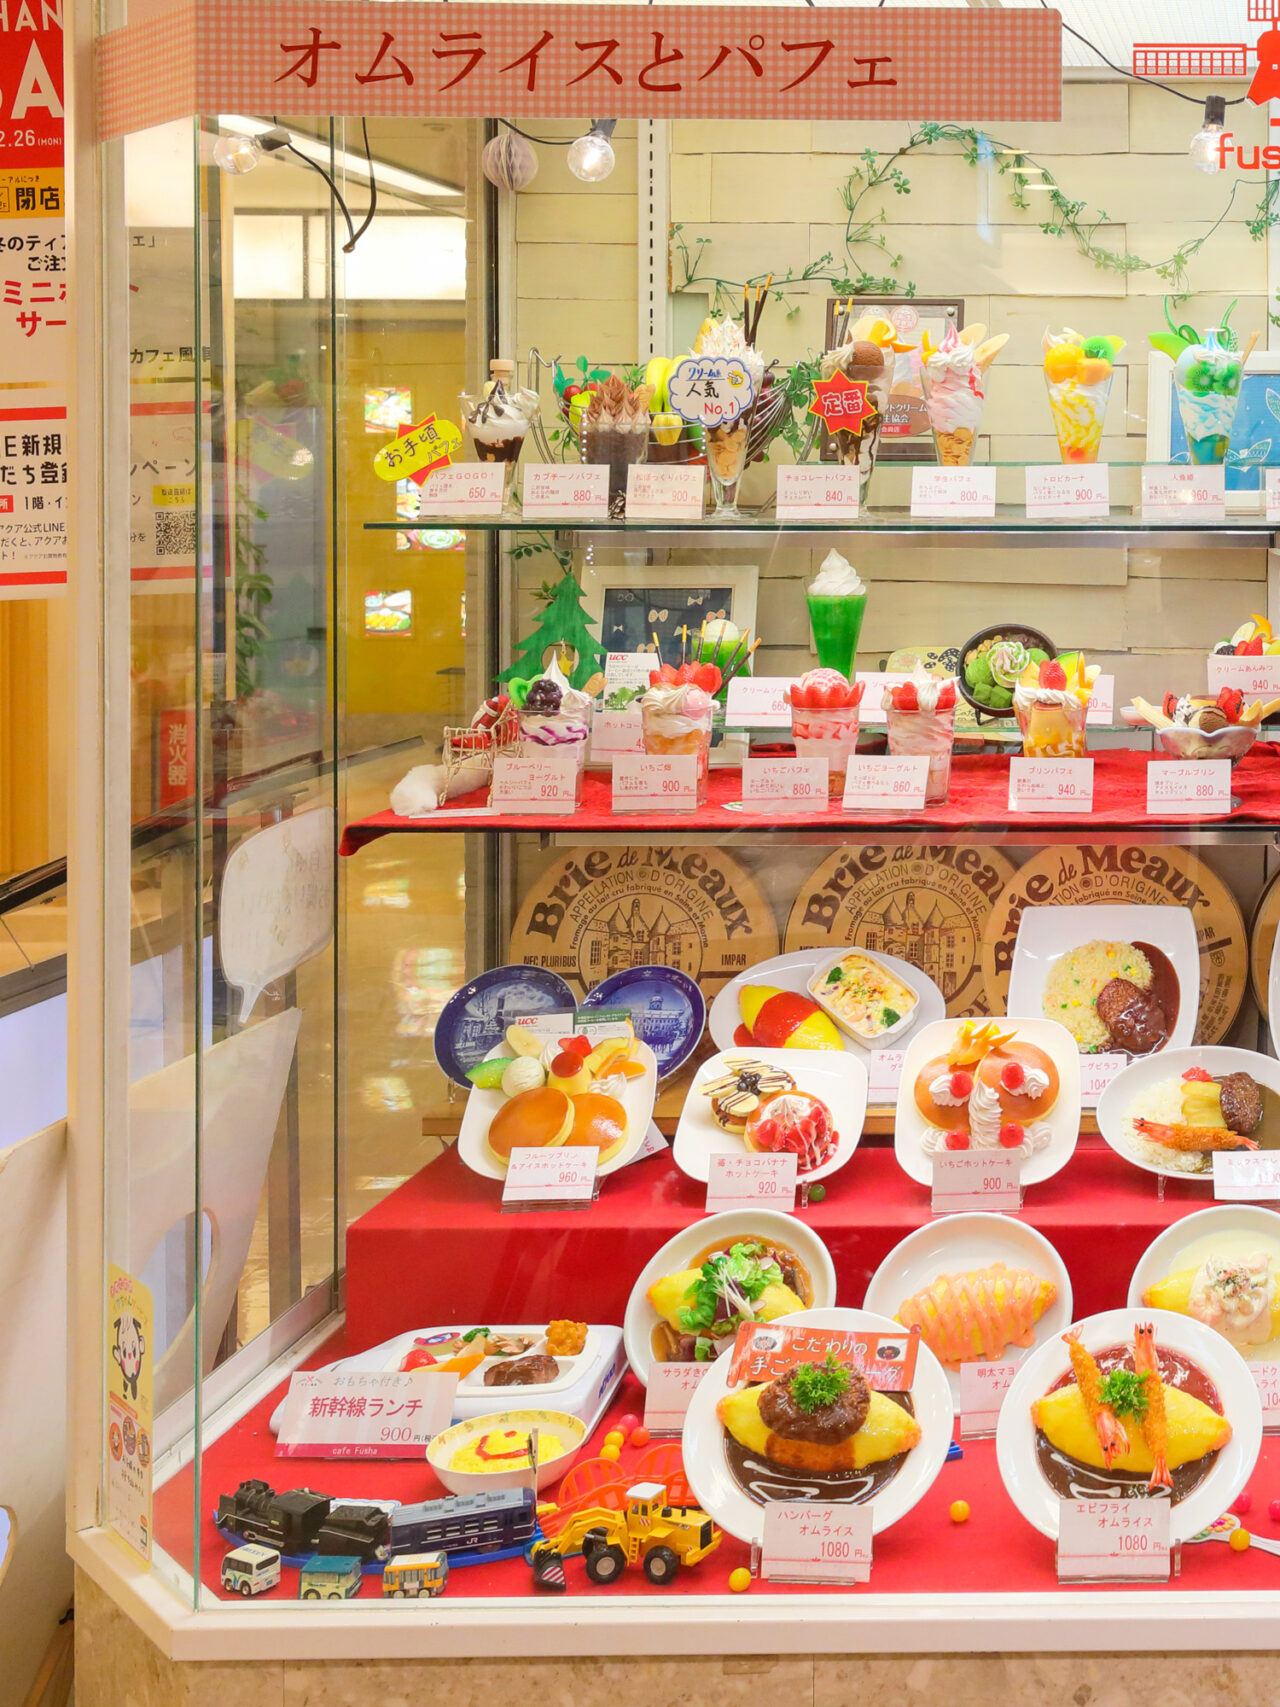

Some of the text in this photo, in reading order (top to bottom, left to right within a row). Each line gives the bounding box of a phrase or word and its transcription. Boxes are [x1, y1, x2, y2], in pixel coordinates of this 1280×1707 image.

[273, 26, 898, 93] オムライスとパフェ
[37, 138, 62, 146] (MON)
[15, 186, 60, 211] 閉店
[27, 254, 65, 272] ご注
[686, 380, 720, 399] 人気
[703, 401, 735, 416] No.1
[821, 388, 863, 417] 定番
[384, 423, 442, 469] お手頃
[426, 437, 463, 462] パフェ
[785, 473, 854, 482] チョコレートパフェ
[468, 487, 487, 499] 650
[573, 490, 591, 502] 880
[671, 490, 688, 502] 900
[825, 490, 843, 502] 840
[960, 490, 978, 502] 800
[1075, 489, 1093, 500] 900
[1251, 680, 1269, 691] 940
[506, 763, 552, 772] ブルーベリー
[640, 764, 672, 772] いちご畑
[762, 767, 811, 775] いちごパフェ
[858, 764, 919, 773] いちごヨーグルト
[1028, 767, 1073, 776] プリンパフェ
[529, 773, 566, 782] ヨーグルト
[541, 785, 558, 797] 920
[662, 780, 680, 792] 900
[792, 783, 811, 795] 880
[892, 781, 910, 793] 860
[1058, 783, 1076, 796] 940
[1196, 784, 1214, 796] 880
[1076, 845, 1211, 909] Meaux
[721, 953, 747, 966] IMPAR
[524, 1152, 579, 1160] フルーツプリン
[939, 1159, 1013, 1169] いちごホットケーキ
[558, 1171, 577, 1184] 960
[725, 1169, 779, 1178] ホットケーキ
[758, 1181, 776, 1194] 920
[983, 1176, 1001, 1190] 900
[791, 1334, 868, 1355] こだわりの
[977, 1367, 1015, 1378] 明太マヨ
[307, 1395, 424, 1419] 新幹線ランチ
[379, 1426, 413, 1442] 900
[331, 1446, 378, 1456] cafe Fusha
[1076, 1503, 1131, 1515] エビフライ
[777, 1510, 834, 1521] ハンバーグ
[1097, 1516, 1154, 1528] オムライス
[799, 1524, 854, 1537] オムライス
[1117, 1534, 1148, 1551] 1080
[819, 1540, 850, 1558] 1080
